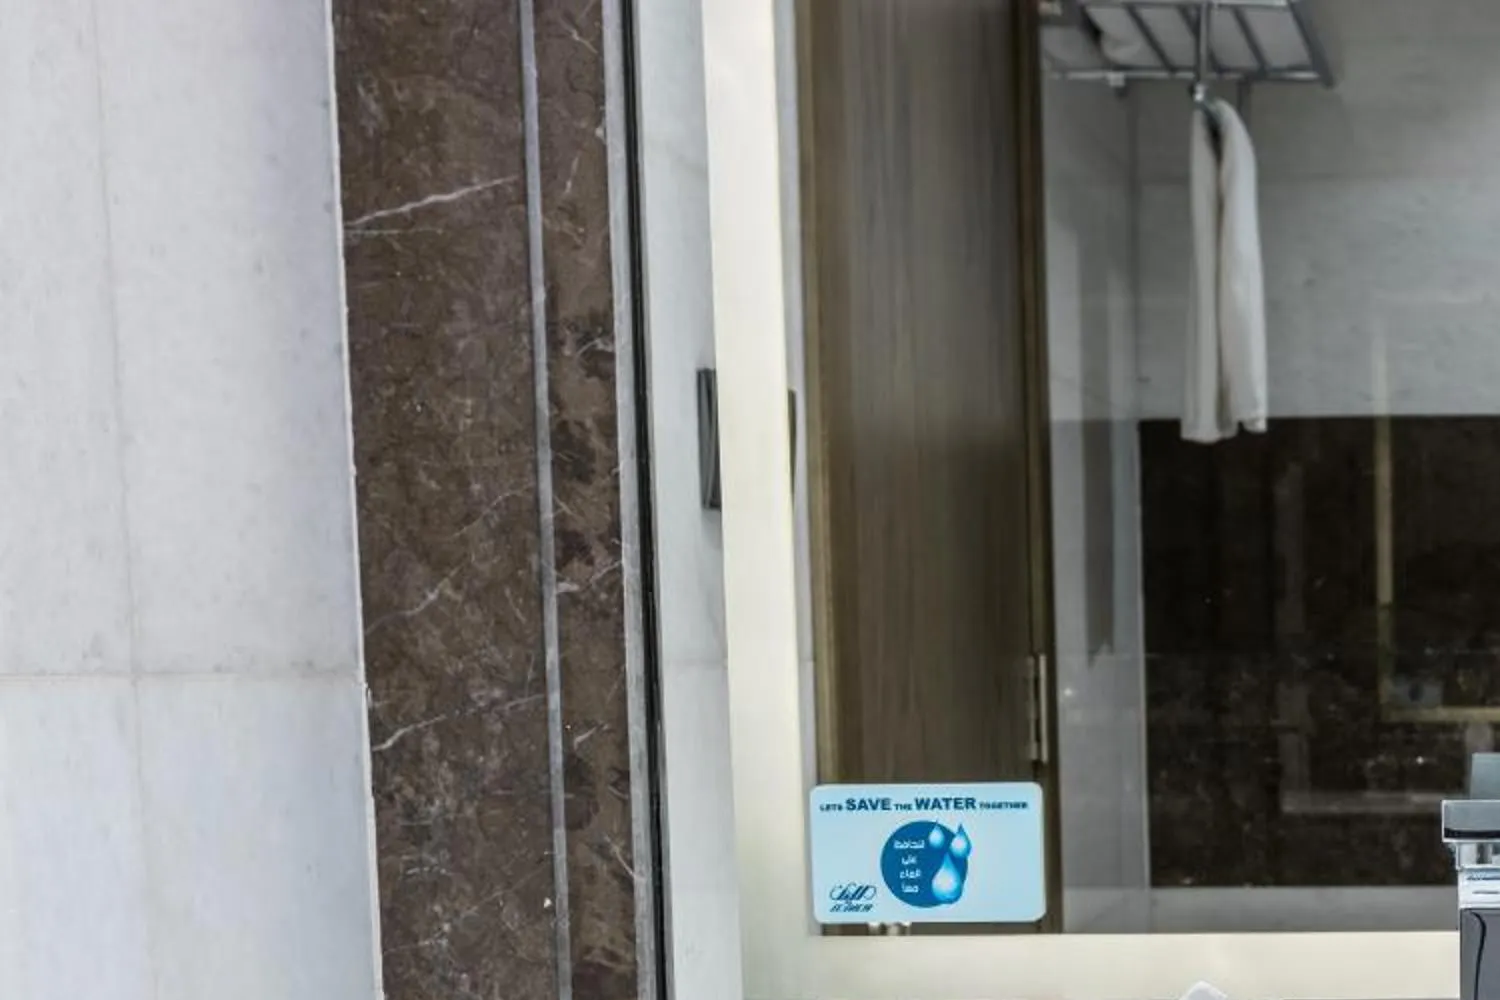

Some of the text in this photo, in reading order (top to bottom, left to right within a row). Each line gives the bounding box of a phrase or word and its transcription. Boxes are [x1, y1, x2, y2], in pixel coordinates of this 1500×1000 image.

[846, 797, 892, 811] SAVE
[894, 803, 912, 811] THE
[914, 797, 977, 811] WATER
